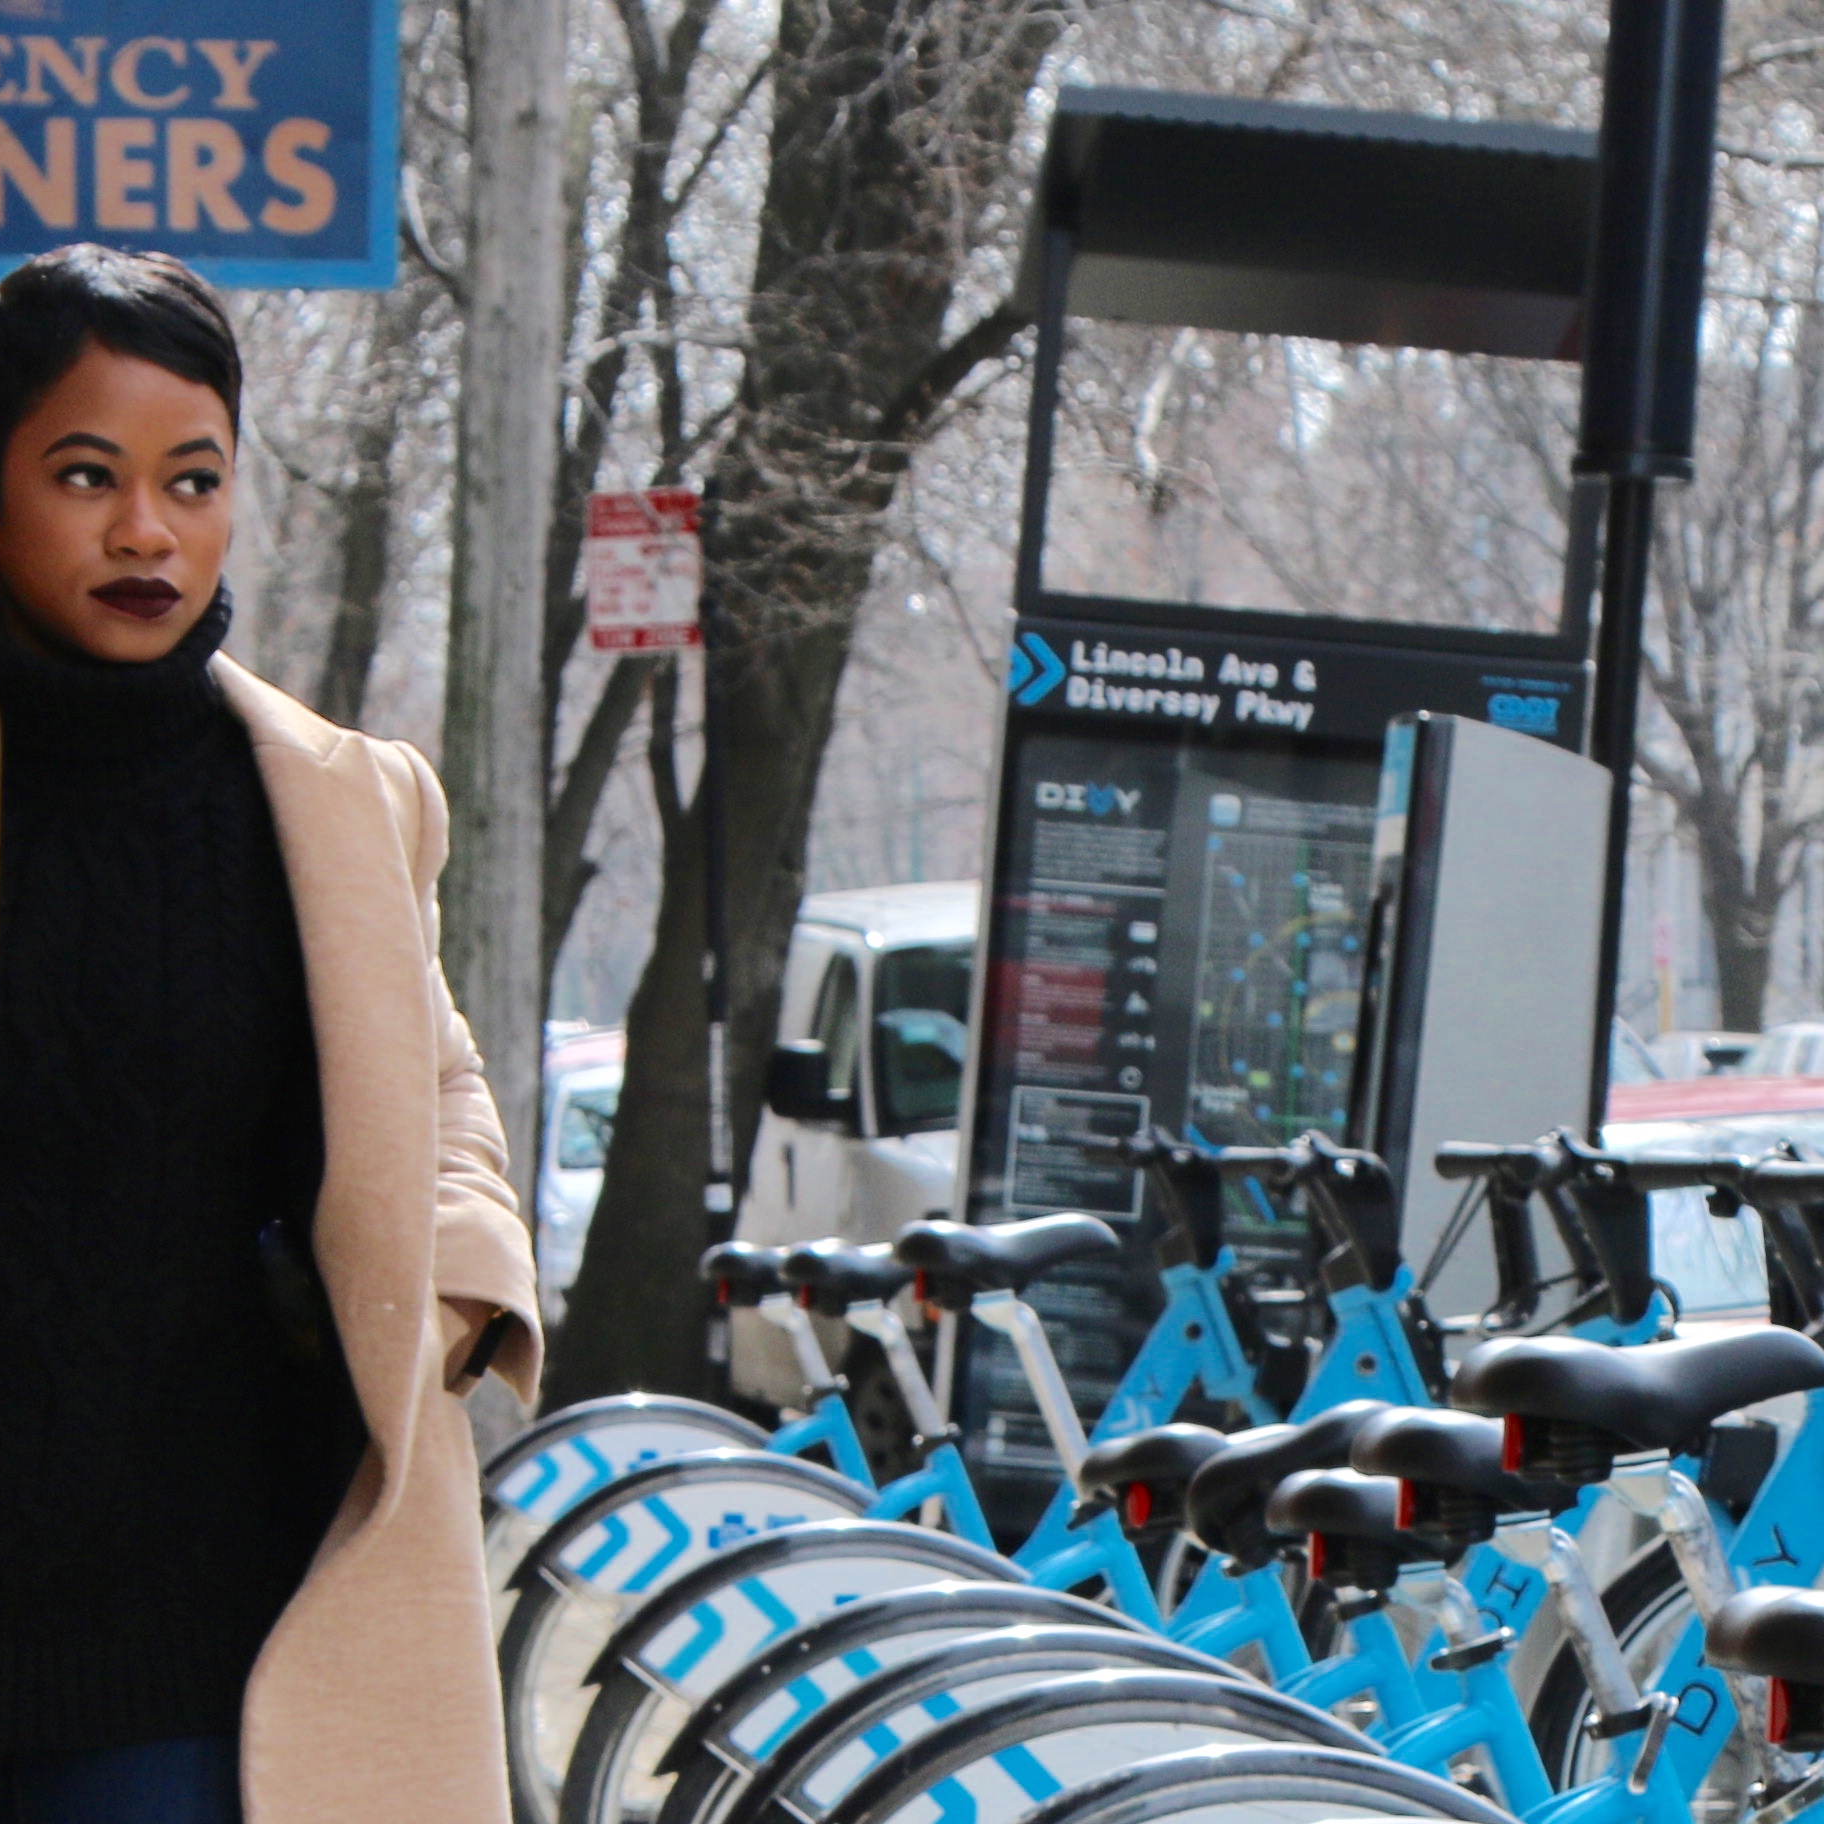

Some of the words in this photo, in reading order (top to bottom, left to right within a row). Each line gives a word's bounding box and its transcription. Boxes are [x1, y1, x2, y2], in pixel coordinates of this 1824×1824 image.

[1070, 639, 1205, 682] Lincoln
[1217, 652, 1279, 689] Ave
[1292, 659, 1317, 692] &
[1065, 675, 1221, 725] Diversey
[1235, 690, 1315, 732] Pkwy
